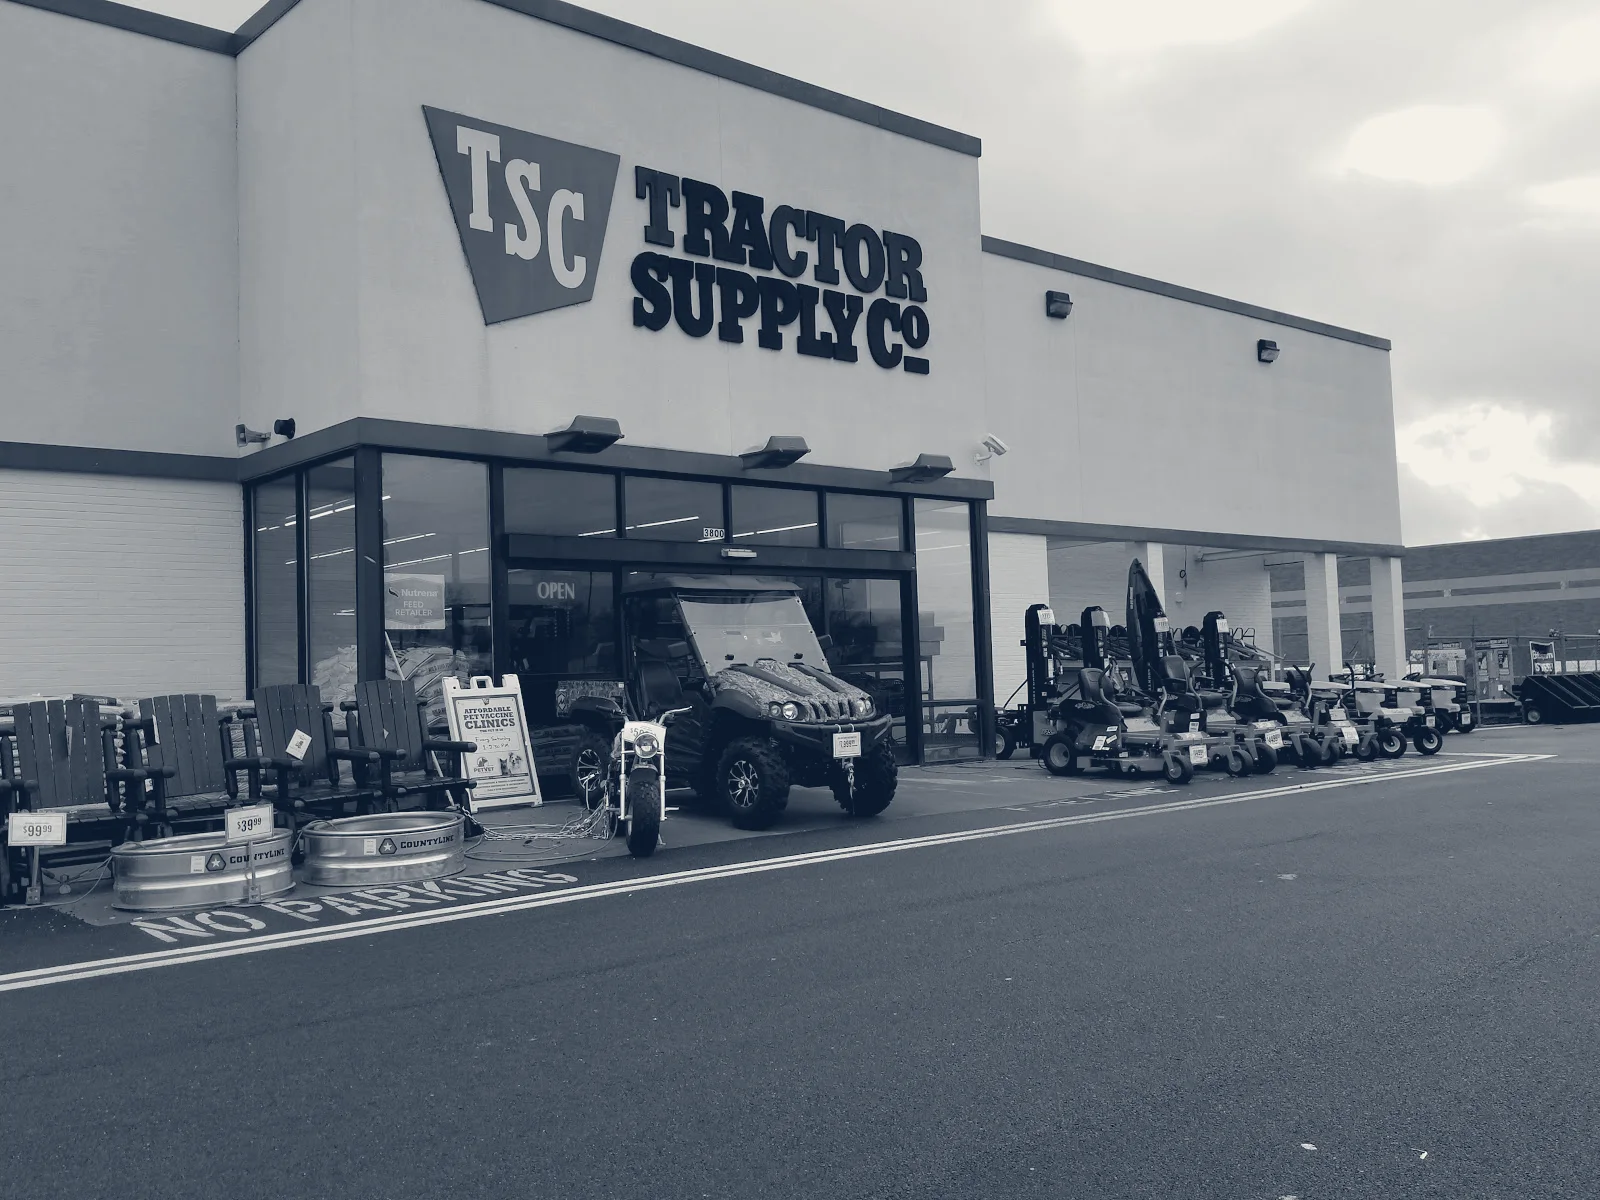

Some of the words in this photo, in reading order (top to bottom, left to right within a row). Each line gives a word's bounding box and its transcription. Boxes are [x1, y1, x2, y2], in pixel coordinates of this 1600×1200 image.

[456, 125, 587, 289] TSC
[635, 166, 928, 301] TRACTOR
[631, 251, 864, 362] SUPPLY
[704, 528, 724, 538] 3800
[401, 589, 438, 597] Nutrena
[537, 582, 576, 599] OPEN
[464, 706, 512, 714] AFFORDABLE
[480, 711, 514, 719] VACCINE
[464, 717, 516, 729] CLINICS
[400, 834, 454, 848] COUNTYLINE
[130, 911, 266, 942] NO
[261, 868, 579, 922] PARKING
